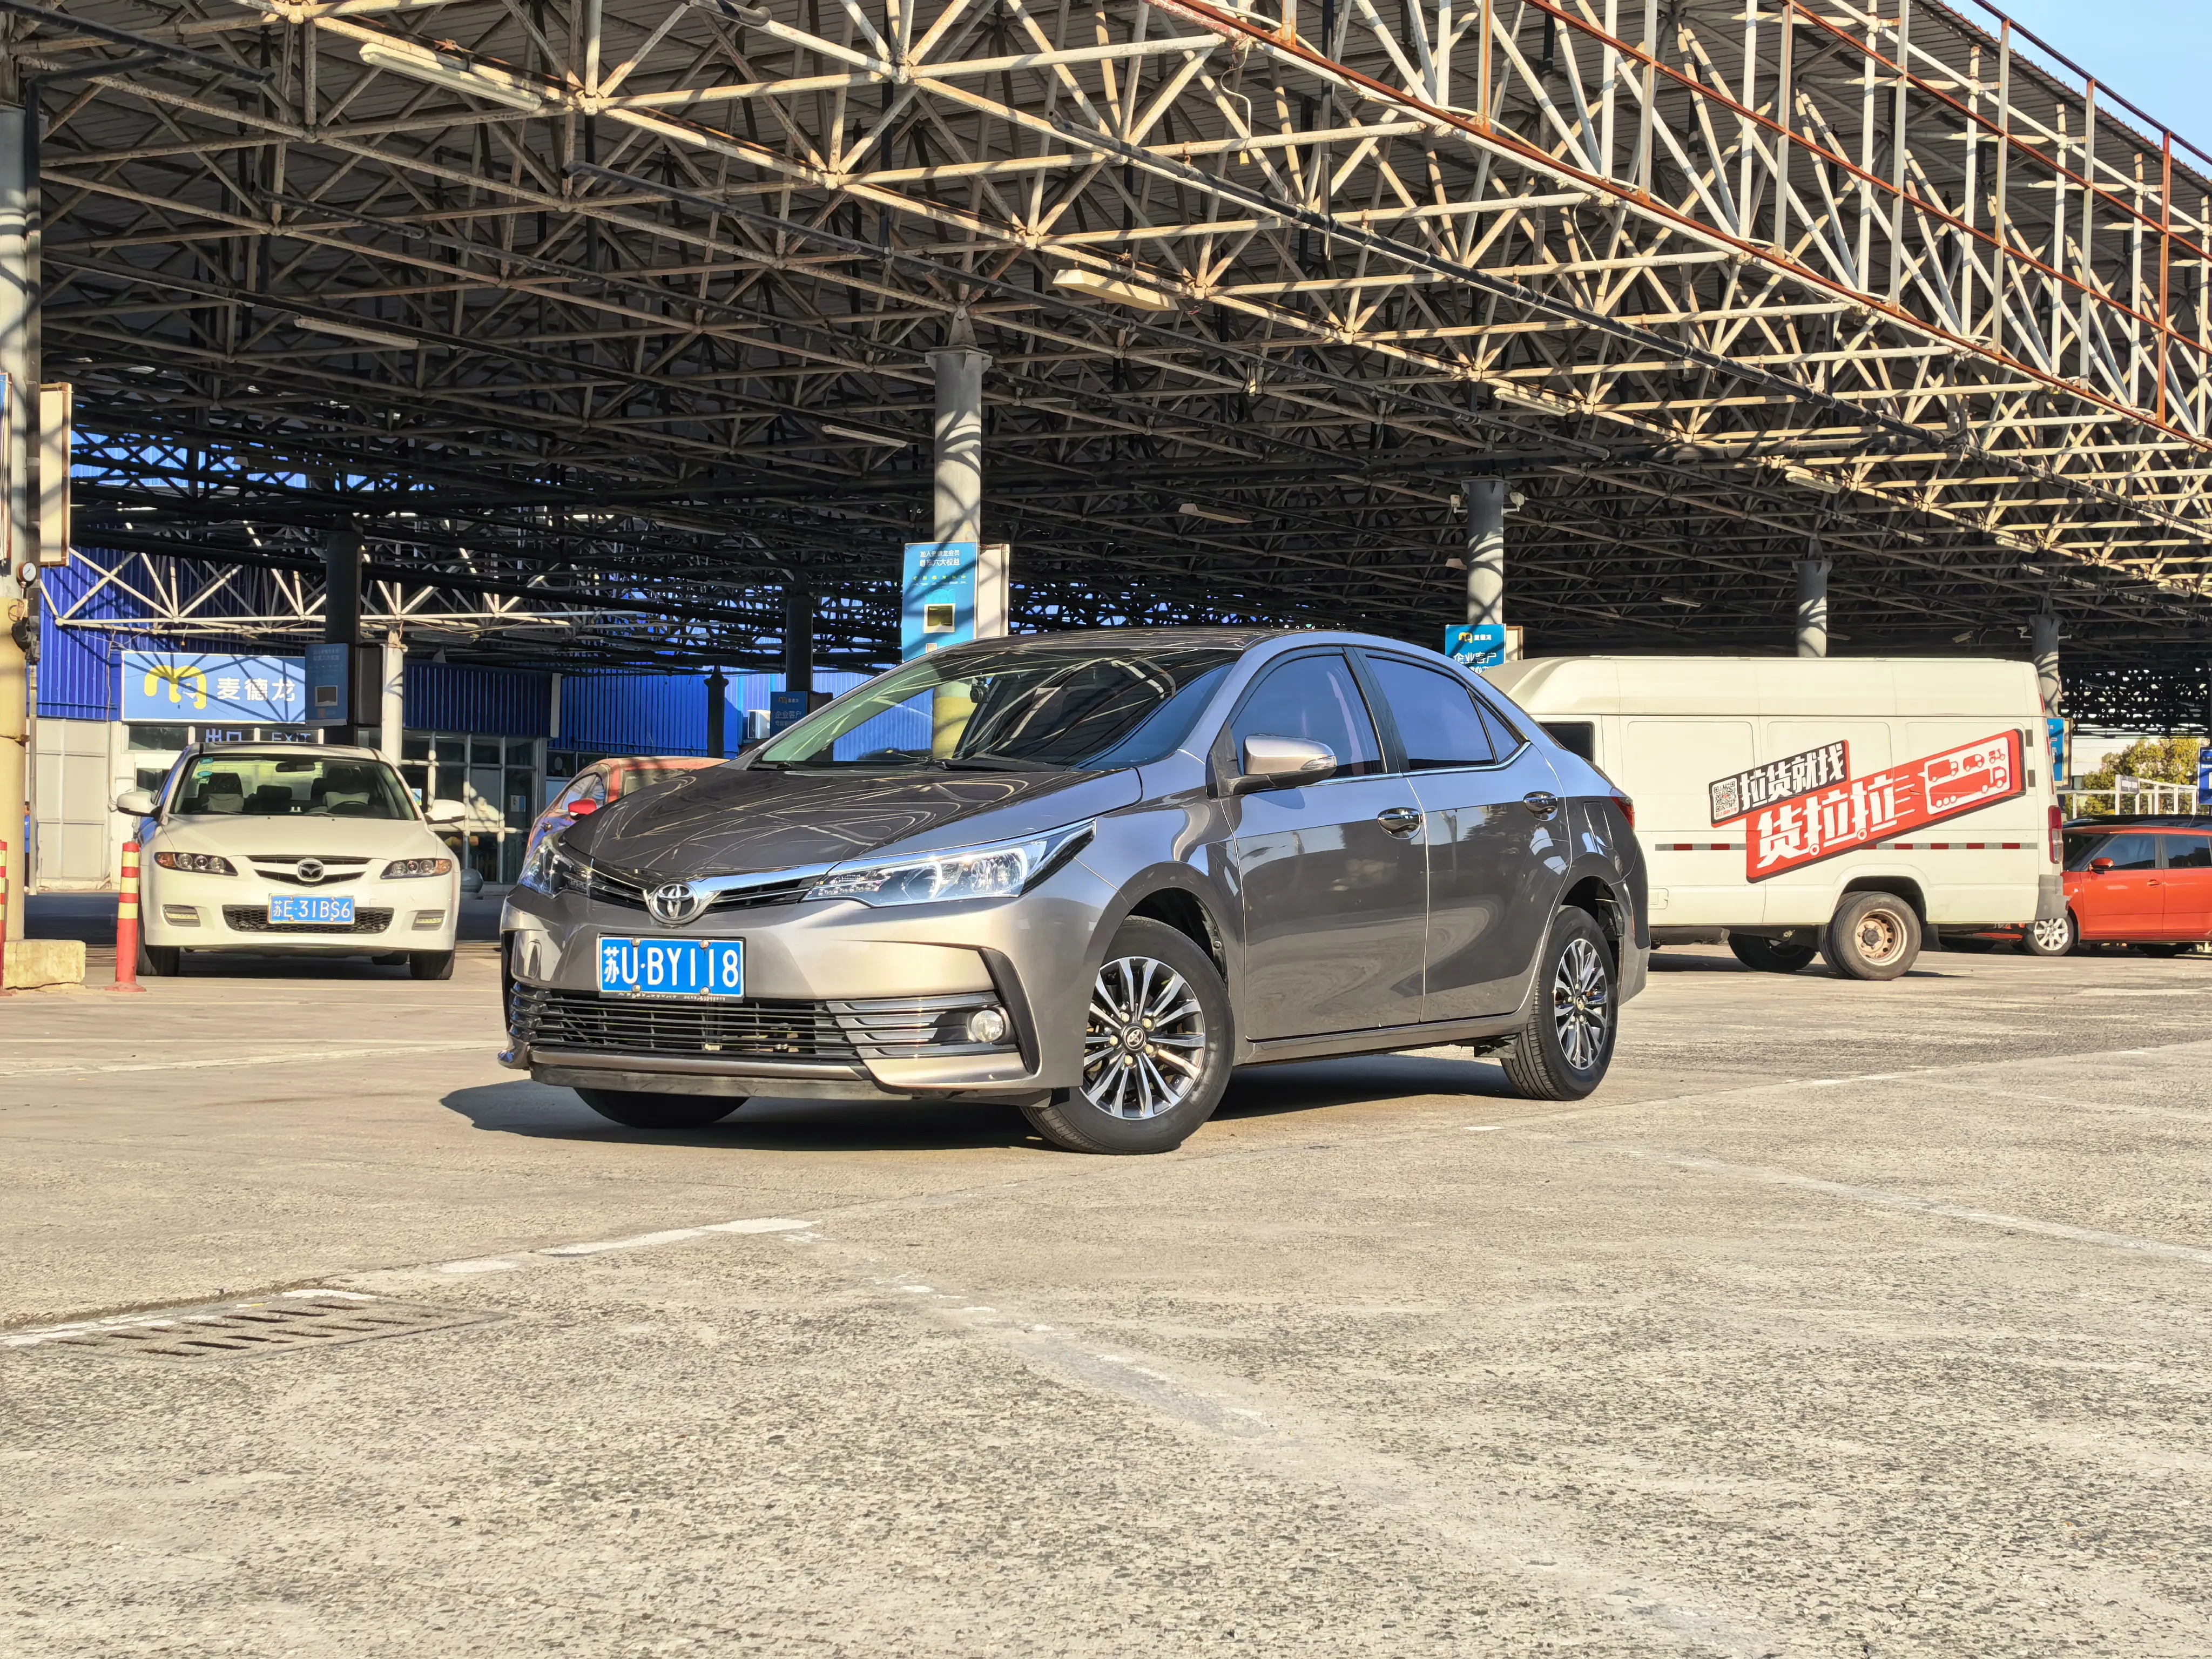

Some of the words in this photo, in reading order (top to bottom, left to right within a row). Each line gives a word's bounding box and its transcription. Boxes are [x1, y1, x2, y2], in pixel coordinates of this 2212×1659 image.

[1453, 651, 1496, 664] 企业客户
[217, 677, 295, 702] 麦德龙
[205, 729, 242, 743] 出口
[272, 732, 312, 743] EXIT
[1739, 742, 1845, 811] 拉货就找
[1756, 773, 1898, 869] 货拉拉
[603, 946, 739, 988] 苏U·BY118
